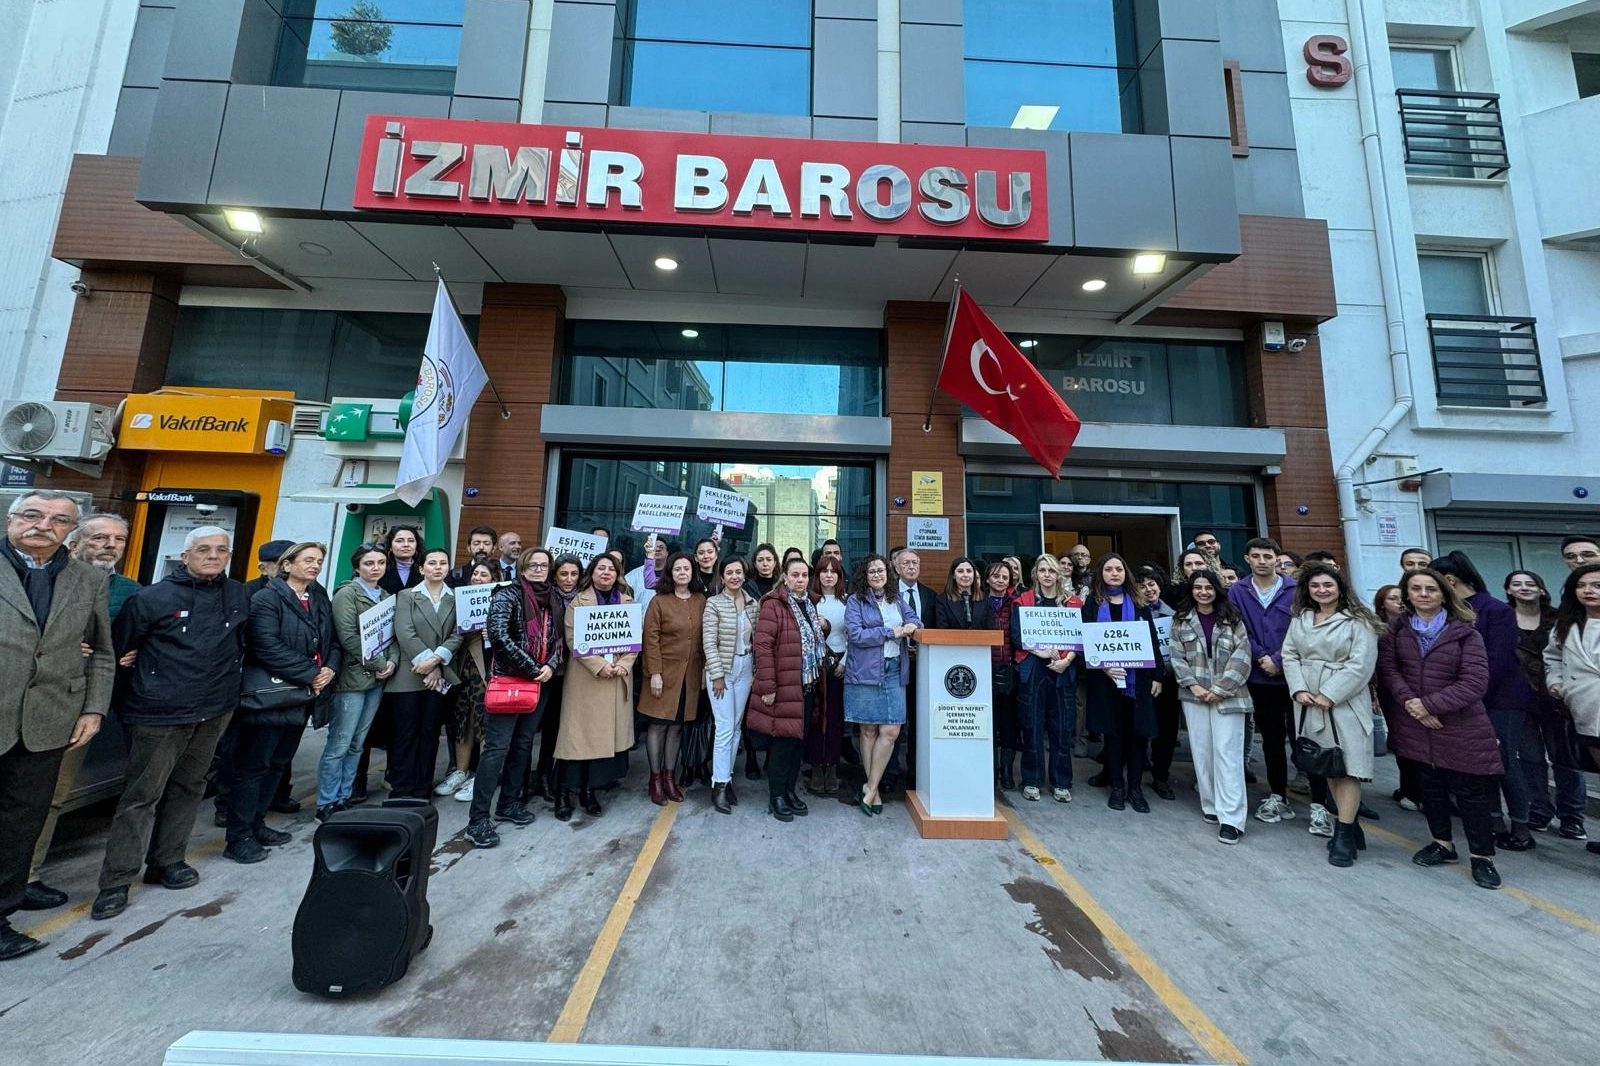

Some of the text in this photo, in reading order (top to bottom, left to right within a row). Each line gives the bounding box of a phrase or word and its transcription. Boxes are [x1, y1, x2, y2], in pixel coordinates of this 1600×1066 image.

[1303, 34, 1353, 87] S
[372, 121, 1032, 230] İZMİR BAROSU
[1076, 349, 1133, 369] İZMİR
[1062, 376, 1145, 395] BAROSU
[159, 414, 249, 433] VakıfBank
[148, 492, 195, 503] VakıfBank
[715, 499, 732, 508] DEĞİL
[638, 509, 682, 518] ENGELLENEMEZ
[558, 536, 596, 551] EŞİT İŞE
[570, 548, 595, 561] ÜCRE
[469, 608, 489, 618] ADA
[589, 610, 629, 620] NAFAKA
[1024, 610, 1077, 619] ŞEKLİ EŞİTLİK
[362, 615, 380, 631] NAFAKA
[587, 620, 631, 631] HAKKINA
[1040, 619, 1063, 627] DEĞİL
[584, 630, 633, 642] DOKUNMA
[1022, 628, 1083, 638] GERÇEK EŞİTLİK
[1103, 629, 1129, 639] 6284
[592, 645, 632, 655] İZMİR BAROSU
[1094, 642, 1142, 654] YAŞATIR
[938, 704, 956, 712] ŞİDDET
